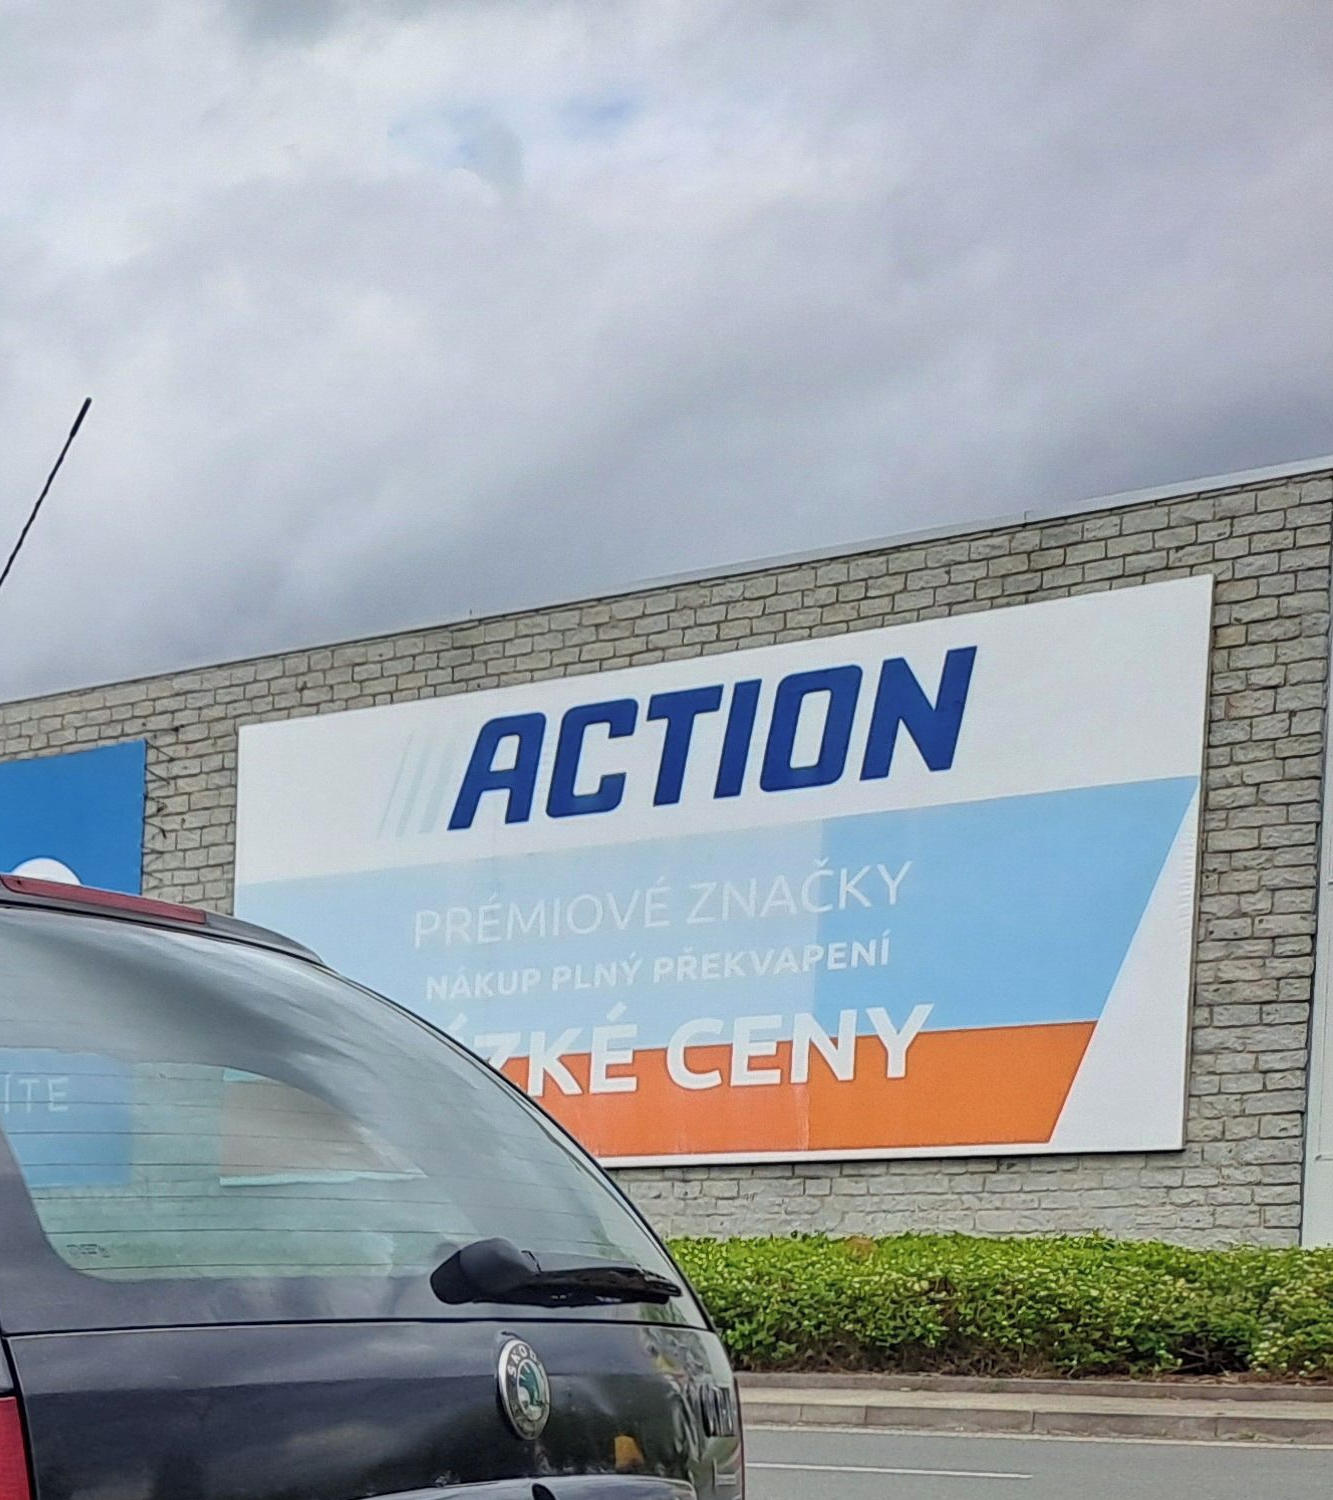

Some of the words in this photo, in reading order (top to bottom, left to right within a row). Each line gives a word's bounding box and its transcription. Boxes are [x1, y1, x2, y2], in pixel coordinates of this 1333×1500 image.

[447, 645, 977, 831] ACTION
[413, 876, 671, 949] PRÉMIOVÉ
[685, 857, 913, 925] ZNAČKY
[425, 963, 541, 1001] NÁKUP
[551, 952, 642, 991] PLNÝ
[652, 929, 892, 984] PŘEKVAPENÍ
[447, 1001, 637, 1097] ZKÉ
[666, 1003, 933, 1091] CENY
